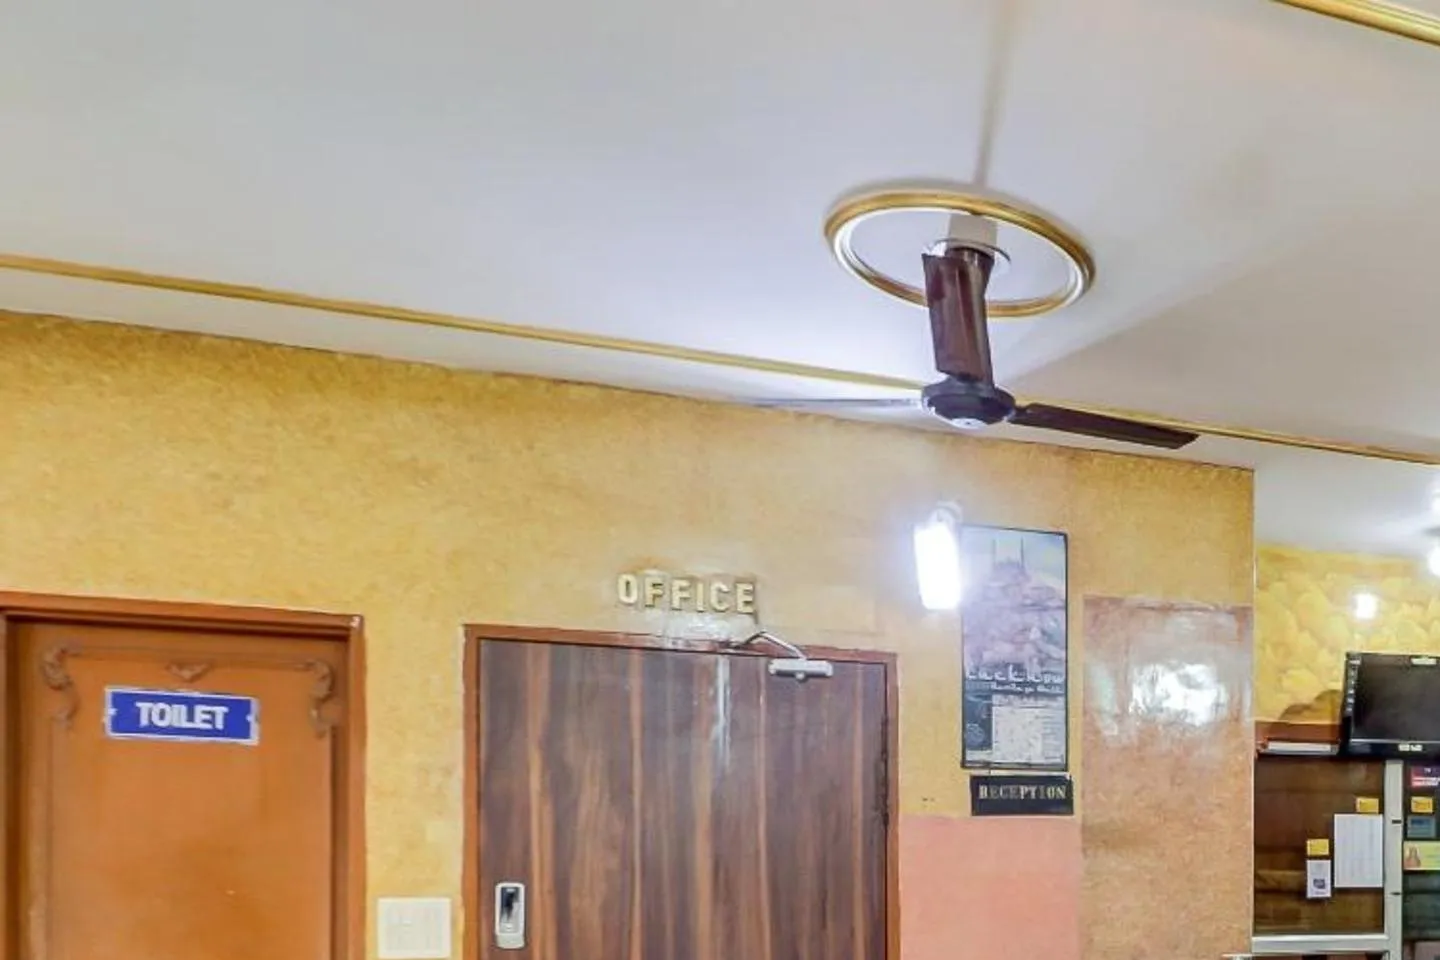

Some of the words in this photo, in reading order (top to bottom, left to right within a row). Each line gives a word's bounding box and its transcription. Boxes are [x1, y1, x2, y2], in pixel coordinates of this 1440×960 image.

[617, 573, 755, 613] OFFICE
[135, 702, 229, 730] TOILET
[979, 784, 1067, 800] RECEPTION
